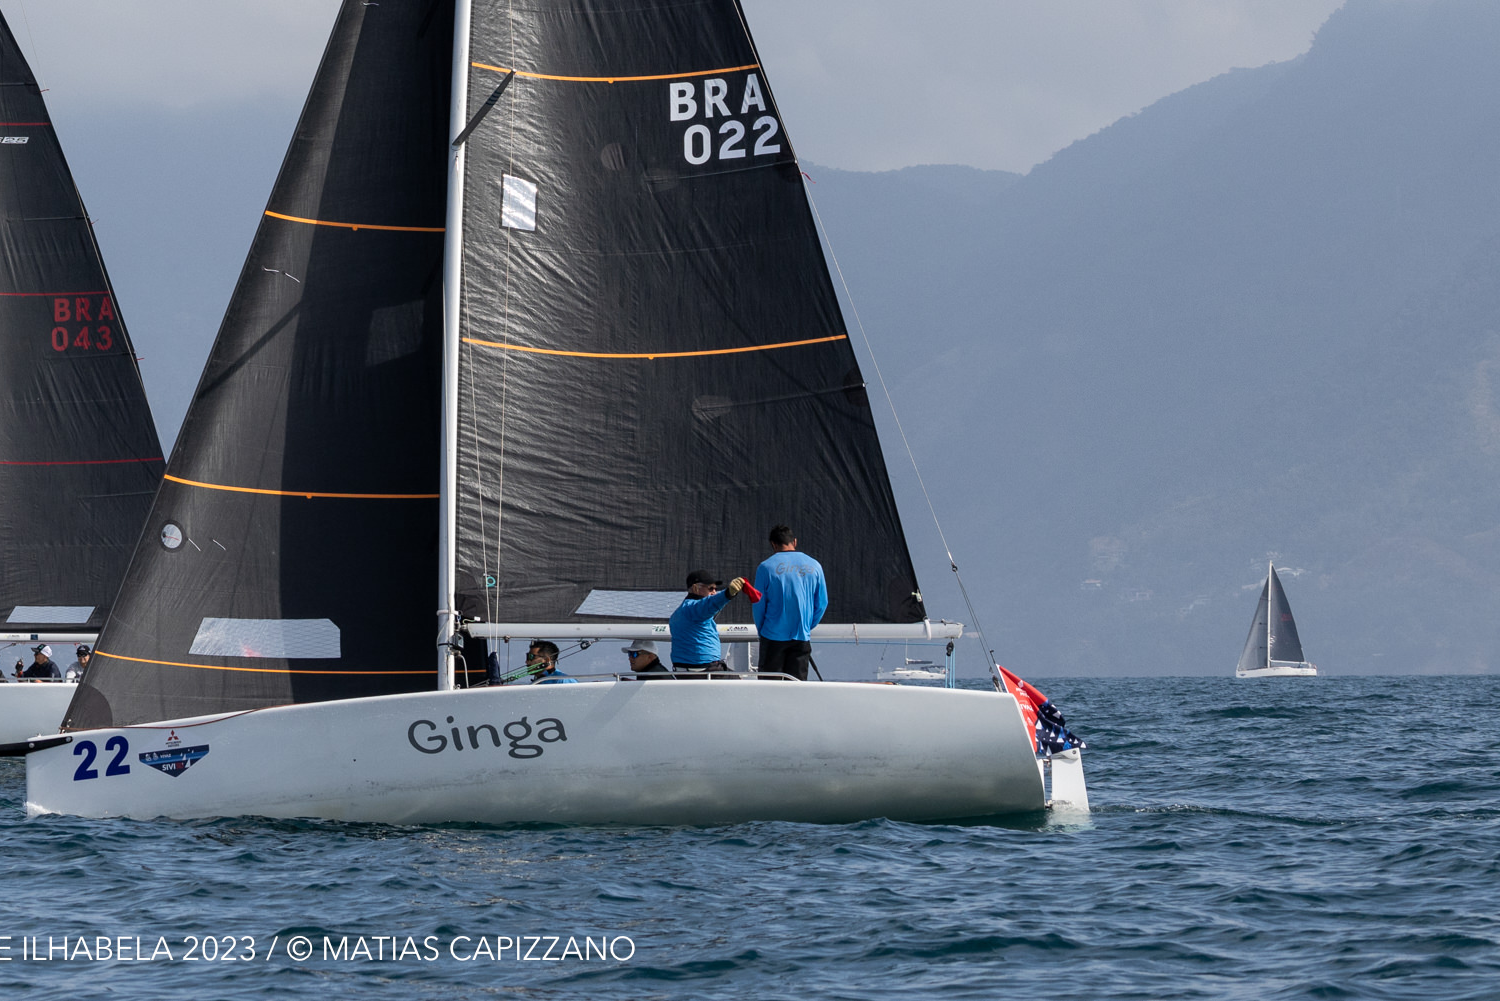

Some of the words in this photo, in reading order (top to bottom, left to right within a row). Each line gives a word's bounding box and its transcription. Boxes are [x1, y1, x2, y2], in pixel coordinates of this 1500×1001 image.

[669, 73, 766, 122] BRA
[683, 115, 781, 165] 022
[53, 296, 114, 322] BRA
[51, 325, 113, 352] 043
[73, 735, 131, 782] 22
[407, 715, 568, 759] Ginga
